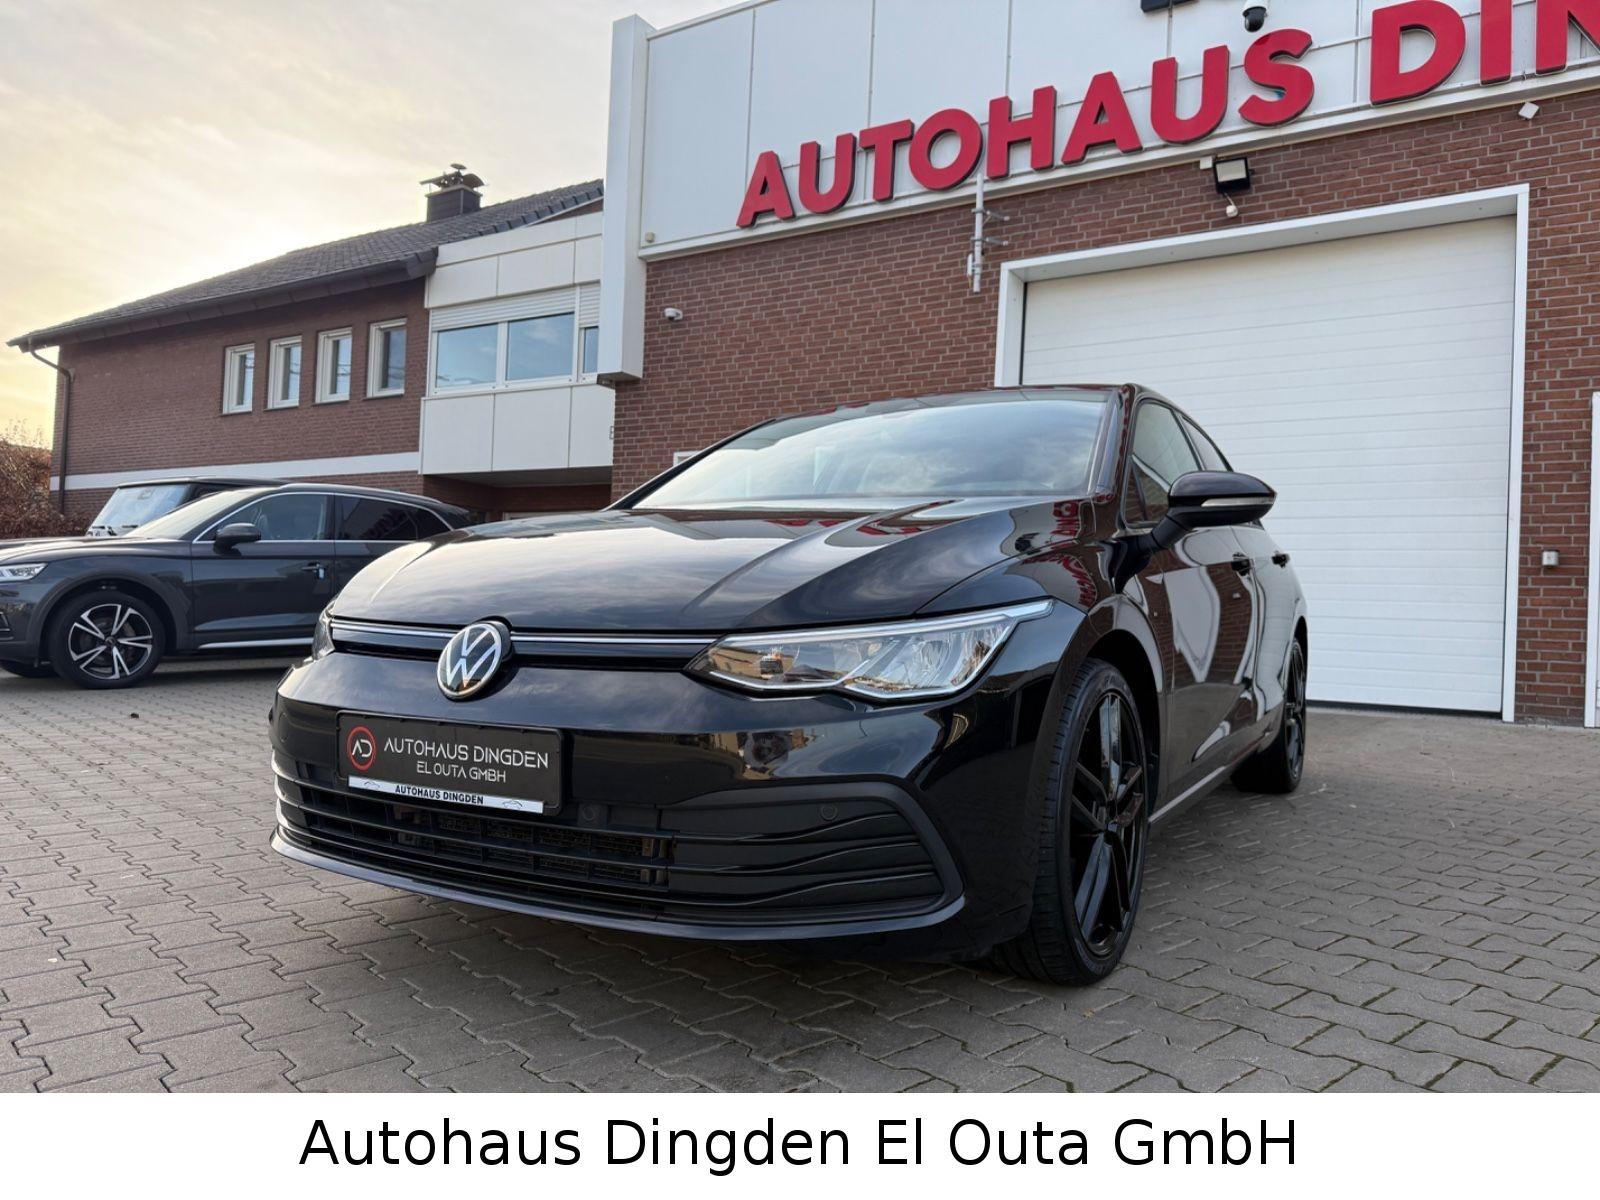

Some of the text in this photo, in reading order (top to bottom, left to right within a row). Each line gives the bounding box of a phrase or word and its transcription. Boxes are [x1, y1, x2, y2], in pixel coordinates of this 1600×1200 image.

[736, 28, 1315, 228] AUTOHAUS
[384, 737, 549, 769] AUTOHAUS DINGDEN
[416, 760, 431, 775] EL
[434, 762, 467, 779] OUTA
[395, 784, 484, 805] AUTOHAUS DINGDEN
